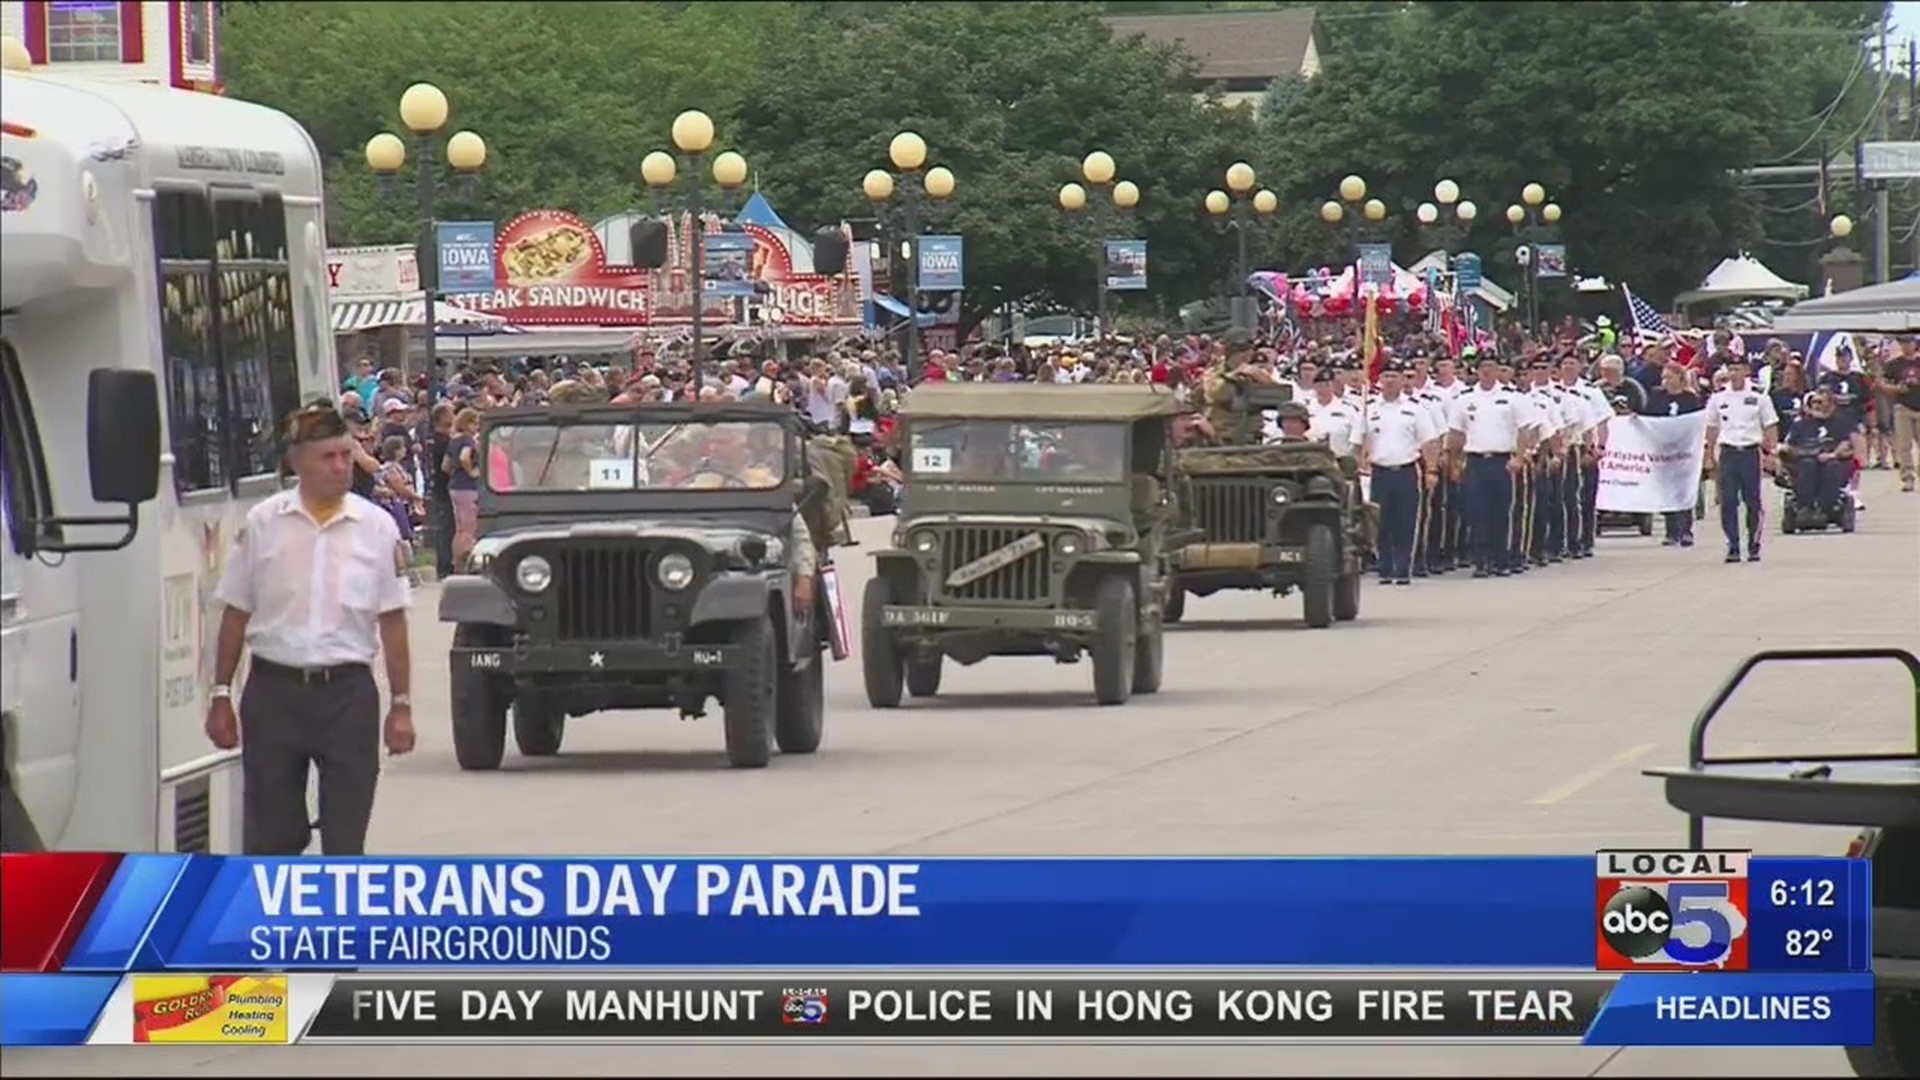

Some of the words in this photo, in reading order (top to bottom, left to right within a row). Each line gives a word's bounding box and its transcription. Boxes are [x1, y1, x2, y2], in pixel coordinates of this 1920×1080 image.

[442, 248, 490, 265] IOWA
[922, 258, 958, 269] IOWA
[457, 286, 526, 311] STEAK
[529, 286, 644, 311] SANDWICH
[923, 455, 942, 467] 12
[1607, 461, 1651, 474] America
[601, 468, 621, 481] 11
